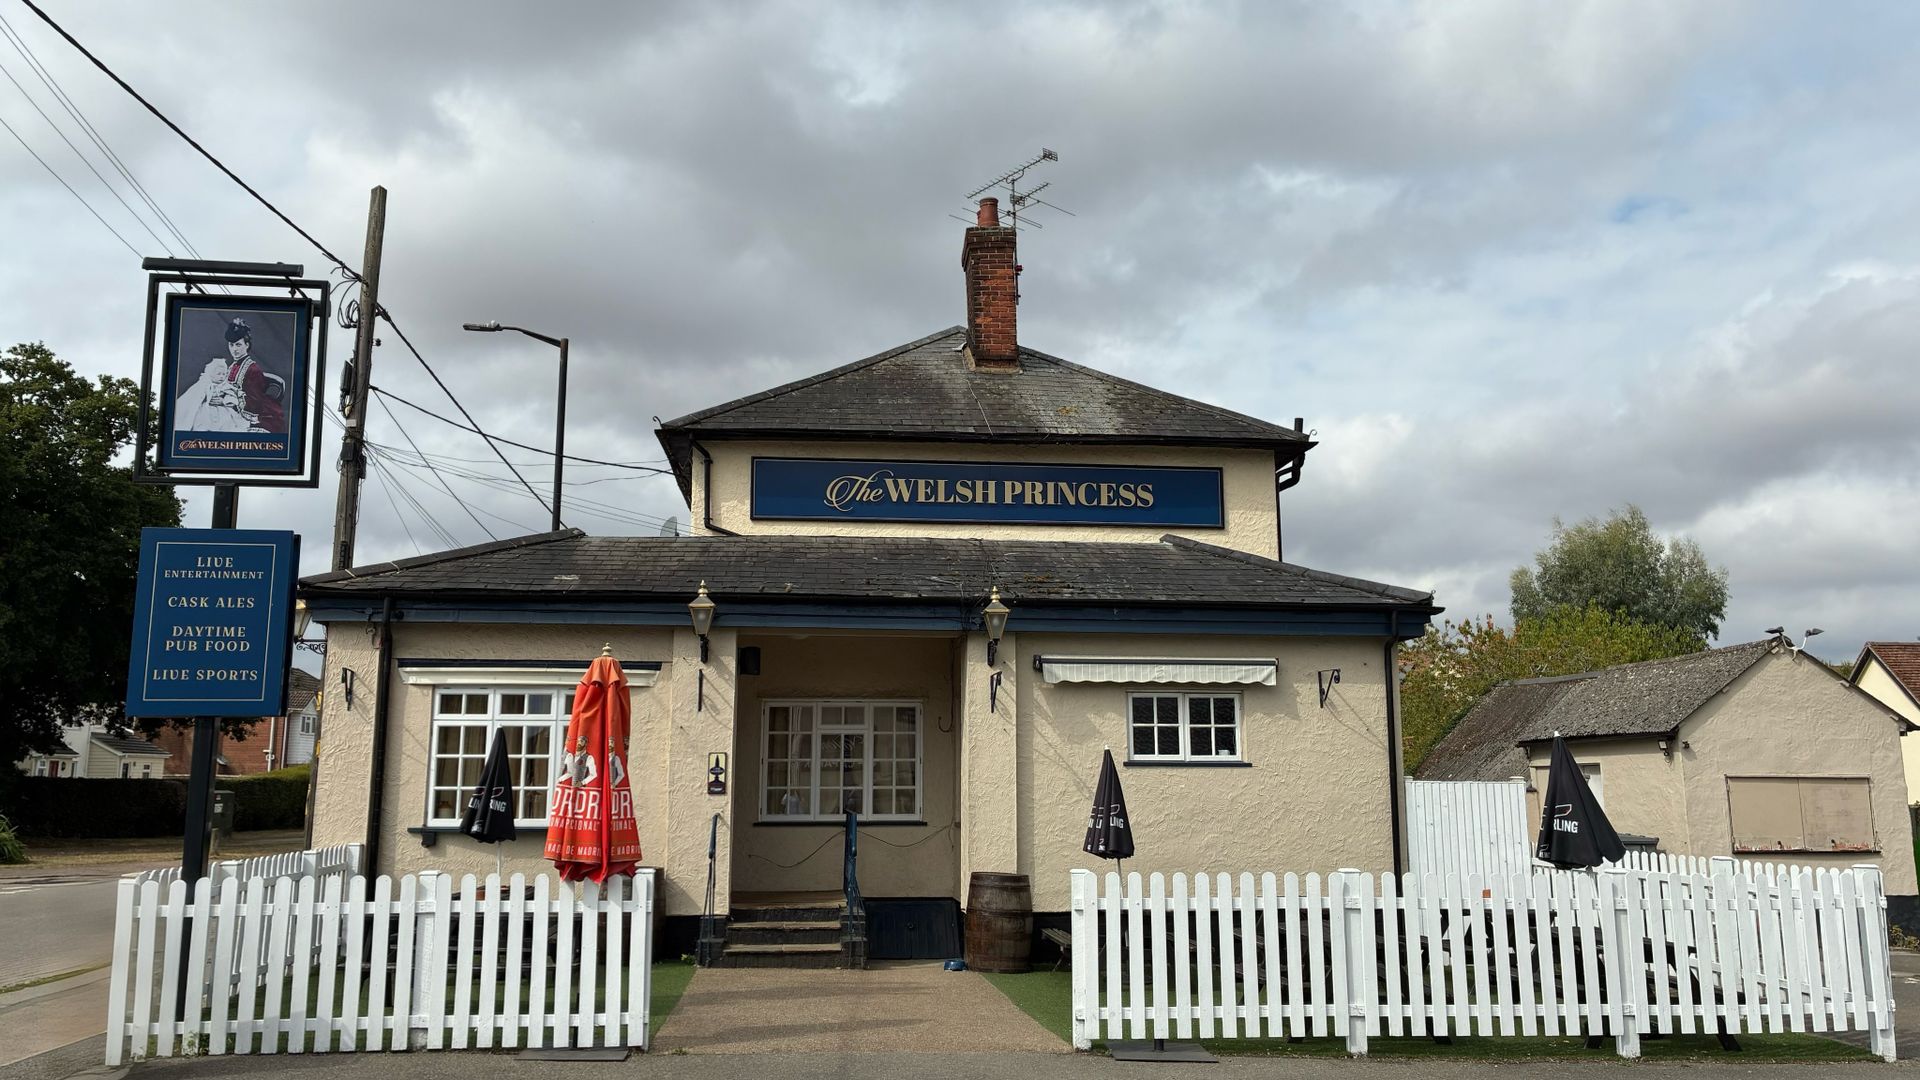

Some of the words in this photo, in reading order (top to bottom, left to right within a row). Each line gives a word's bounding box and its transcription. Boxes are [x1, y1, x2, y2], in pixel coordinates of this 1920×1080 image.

[179, 439, 202, 451] The
[198, 441, 233, 450] WELSH
[235, 442, 283, 450] PRINCESS
[824, 469, 894, 511] The
[885, 478, 997, 504] WELSH
[1003, 481, 1154, 507] PRINCESS
[197, 556, 234, 568] LIVE
[164, 570, 264, 579] ENTERTAINMENT
[168, 596, 209, 608] CASK
[215, 597, 255, 608] ALES
[172, 625, 246, 637] DAYTIME
[165, 640, 198, 652] PUB
[205, 640, 250, 652] FOOD
[152, 669, 190, 681] LIVE
[196, 669, 258, 681] SPORTS
